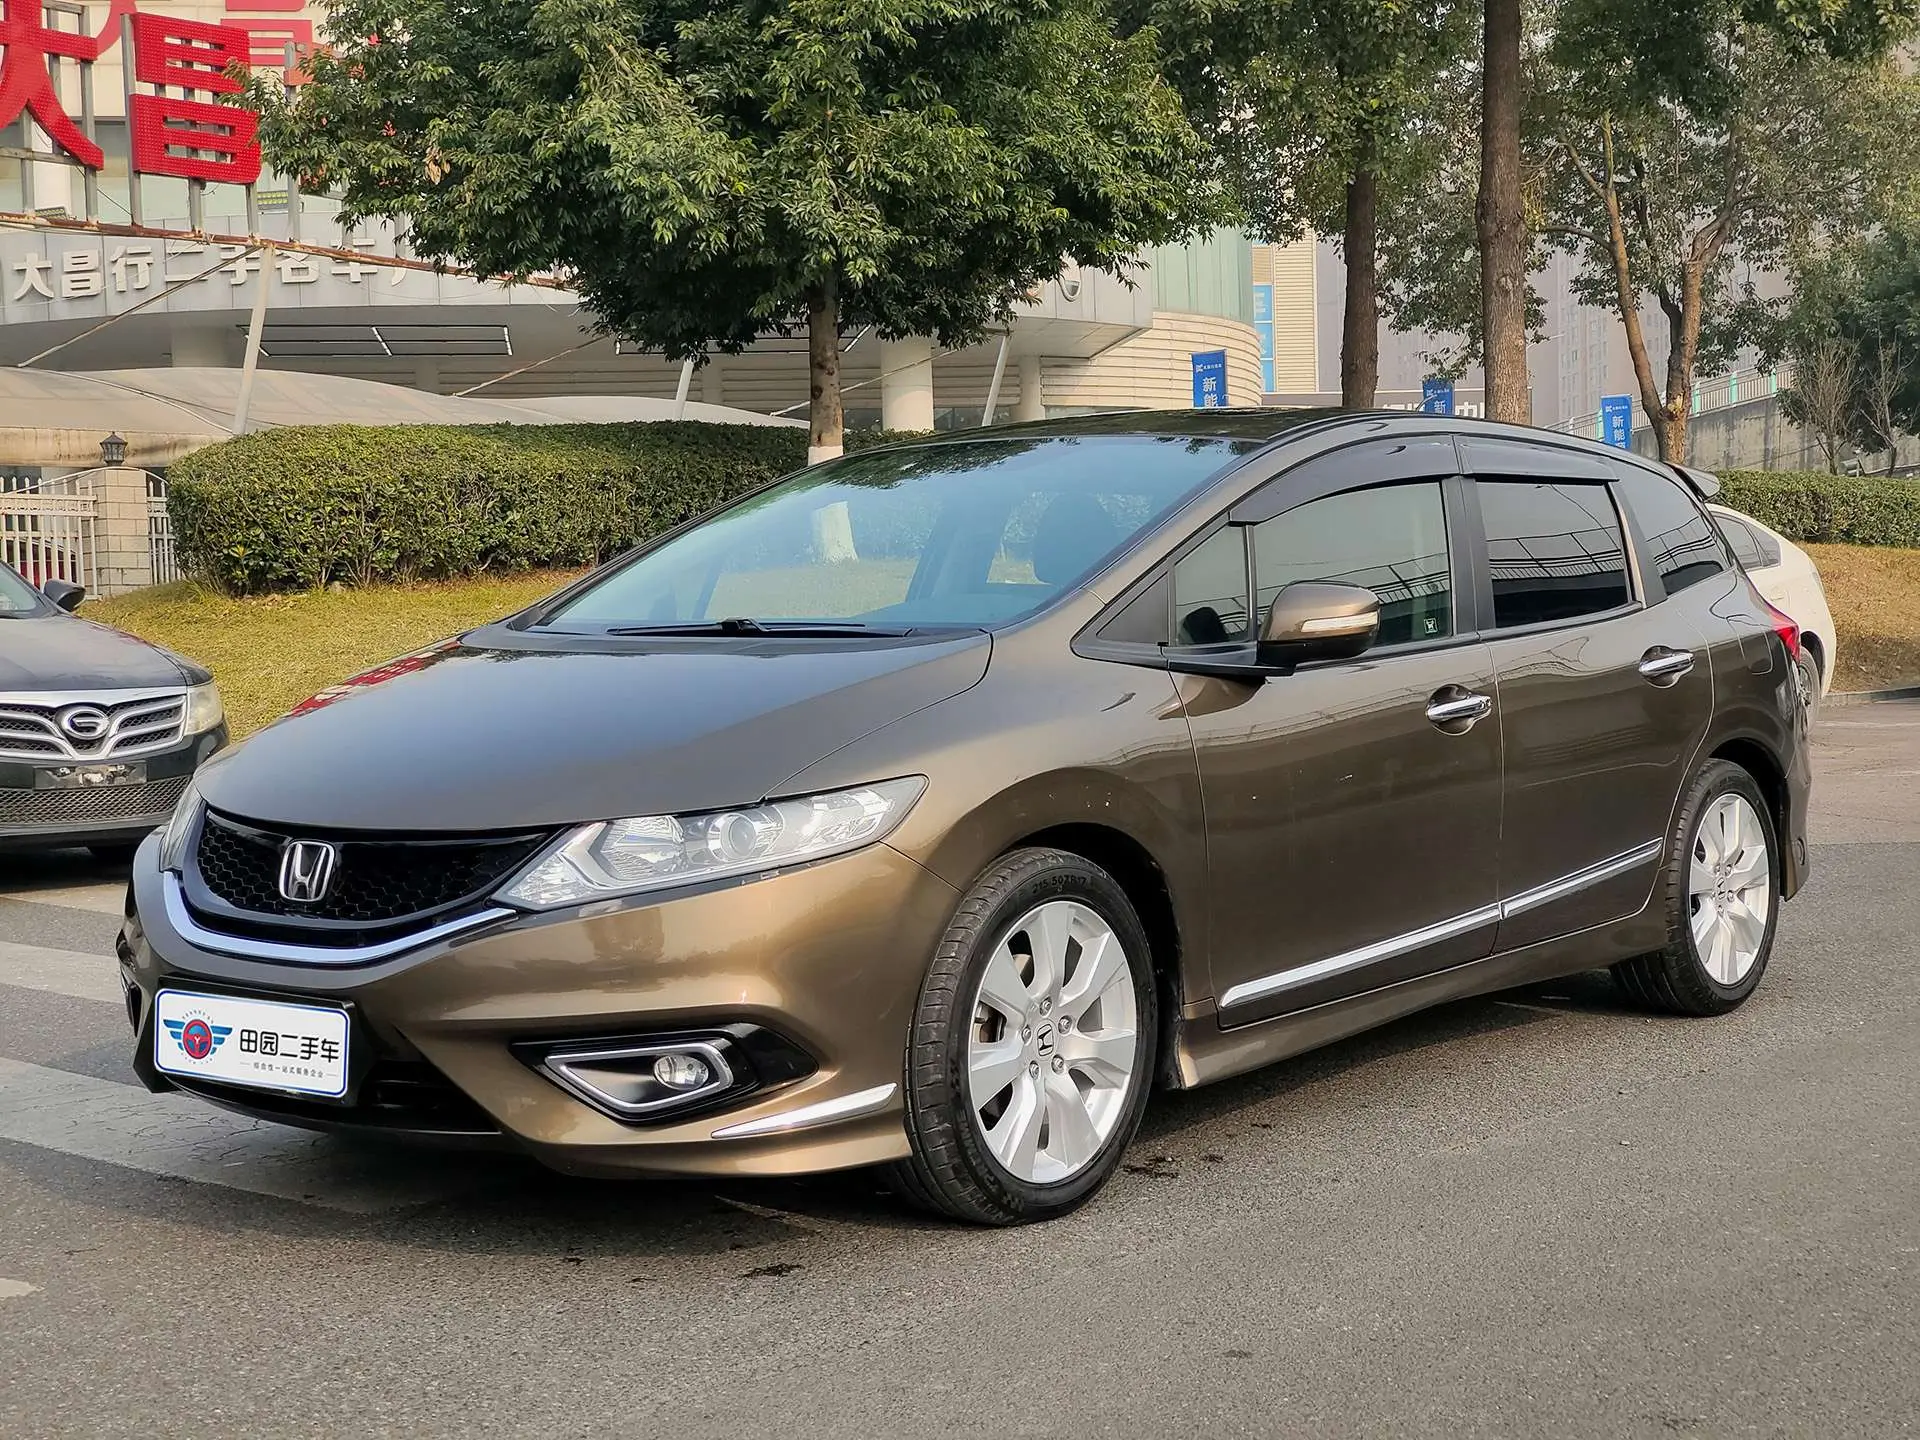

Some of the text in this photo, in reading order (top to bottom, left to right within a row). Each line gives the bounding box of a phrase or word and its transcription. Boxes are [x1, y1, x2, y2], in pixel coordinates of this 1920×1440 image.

[12, 238, 408, 300] 大昌行二手名车
[239, 1028, 340, 1064] 田园二手车
